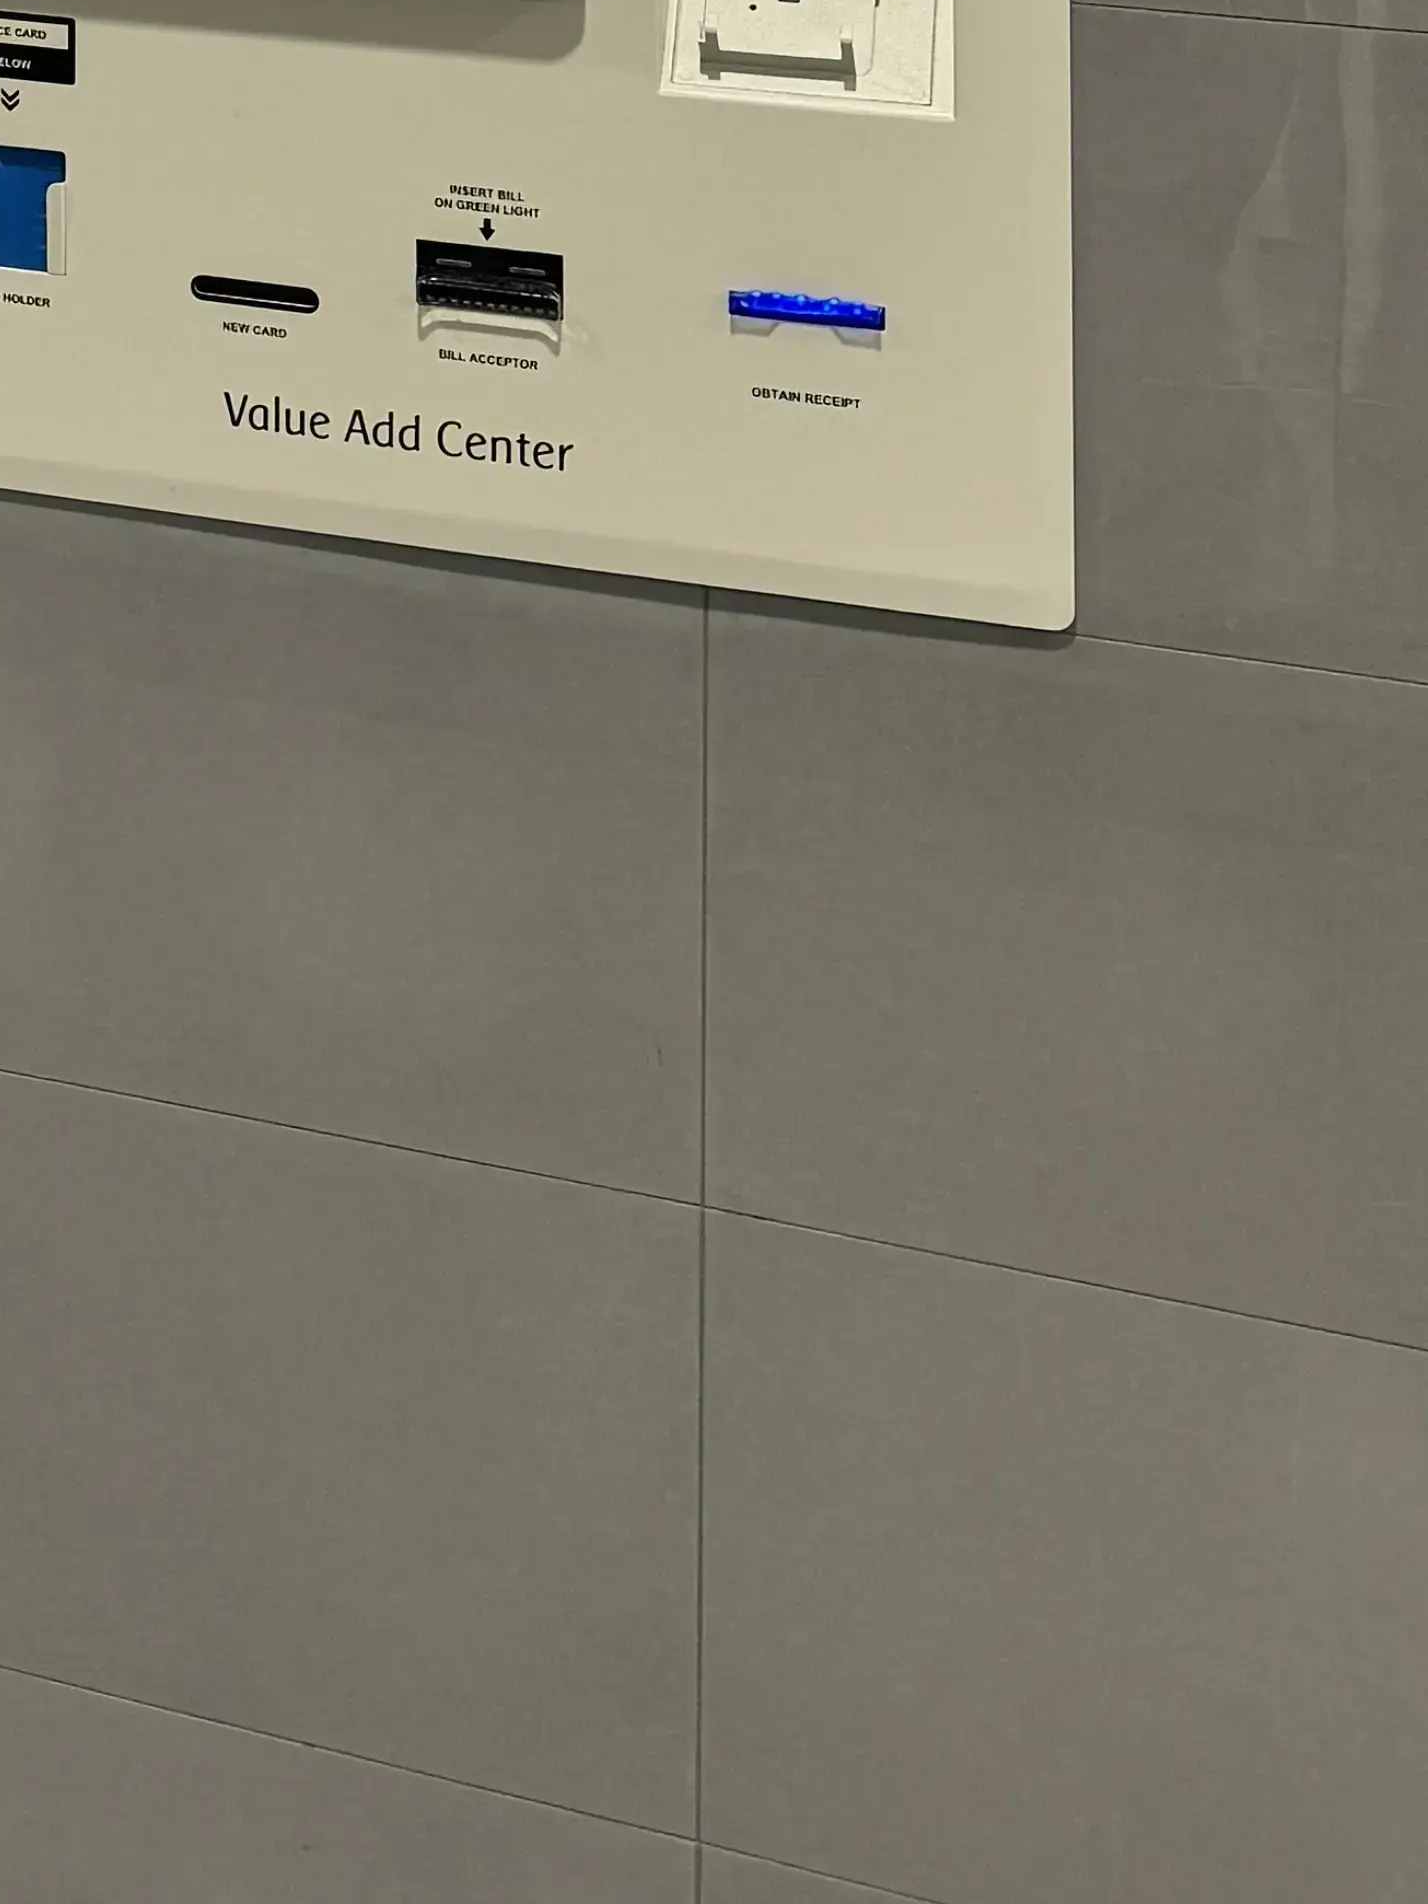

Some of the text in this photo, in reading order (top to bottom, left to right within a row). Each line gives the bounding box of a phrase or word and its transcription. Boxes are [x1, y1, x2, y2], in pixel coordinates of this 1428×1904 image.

[15, 26, 47, 40] CARD
[449, 184, 524, 202] INSERT BILL
[434, 197, 540, 219] ON GREEN LIGHT
[3, 293, 51, 309] HOLDER
[222, 320, 287, 340] NEW CARD
[439, 348, 539, 371] BILL ACCEPTOR
[751, 386, 861, 410] OBTAIN RECEIPT
[223, 391, 574, 472] Value Add Center
